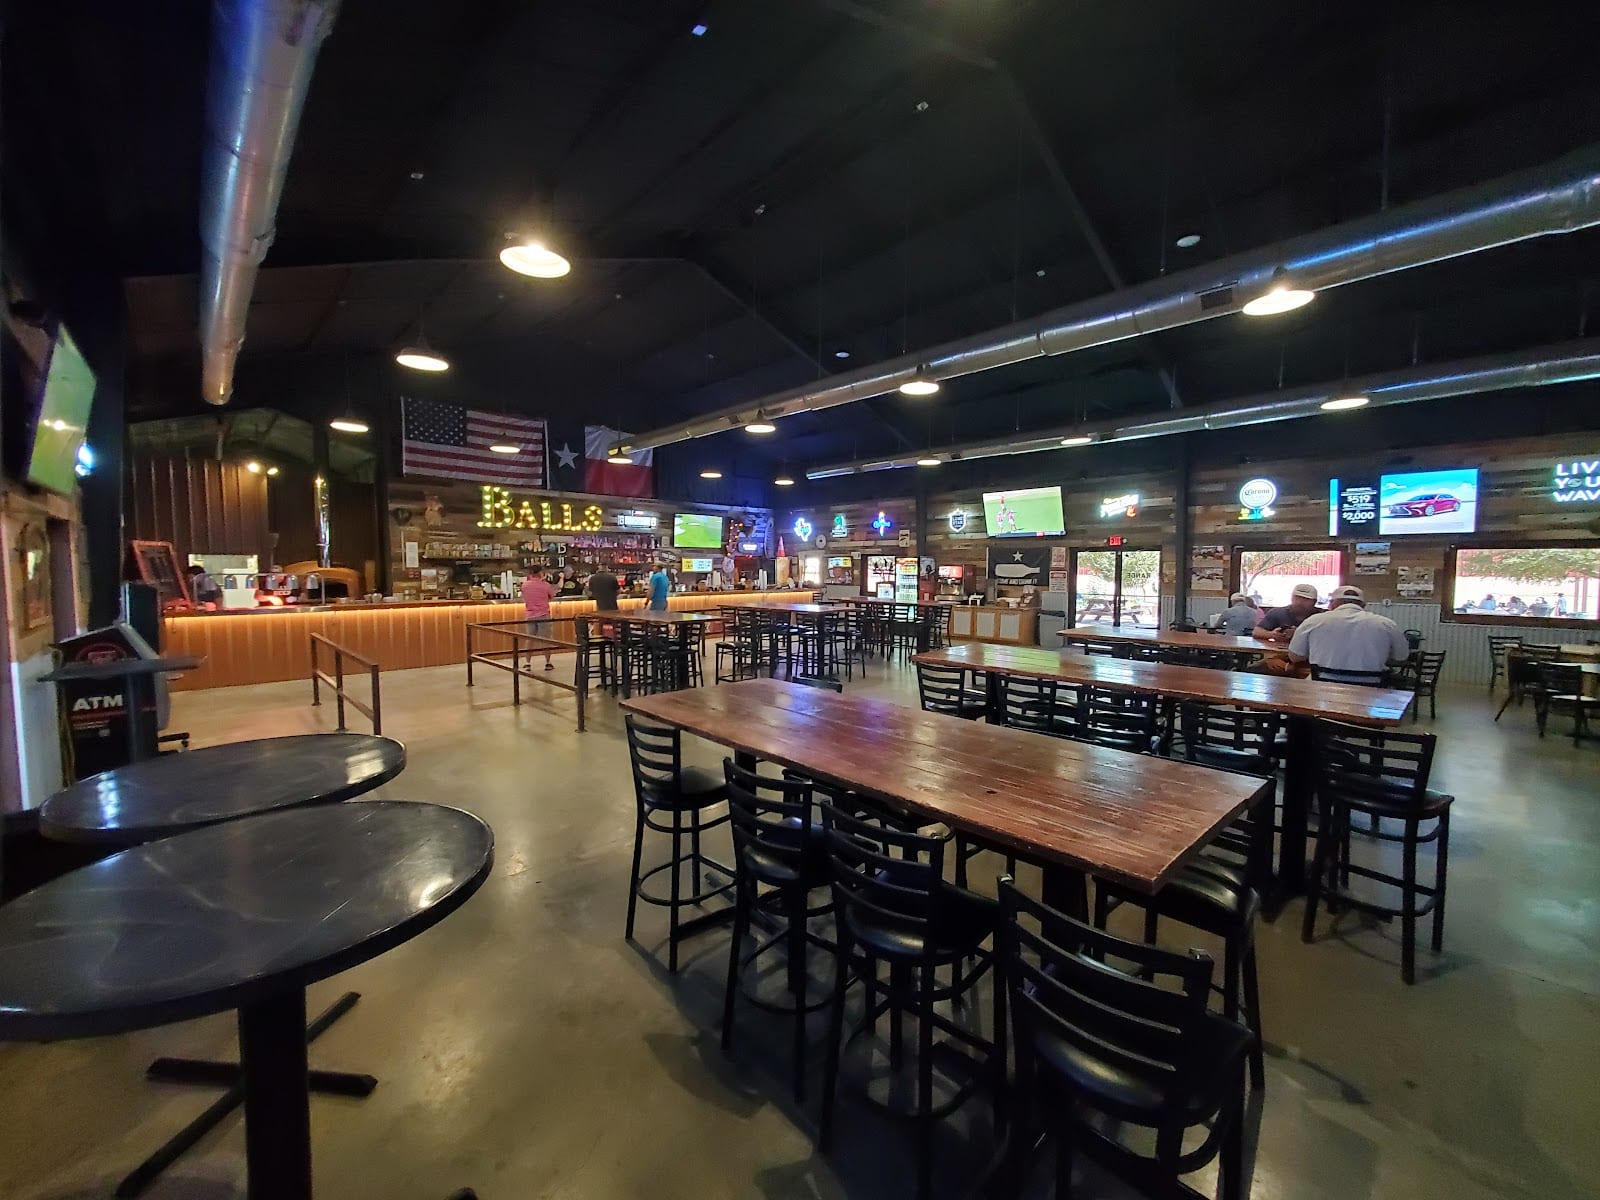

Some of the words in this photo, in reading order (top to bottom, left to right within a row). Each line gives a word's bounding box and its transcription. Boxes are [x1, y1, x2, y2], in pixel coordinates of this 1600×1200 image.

[1244, 488, 1270, 496] Corona
[1346, 494, 1371, 504] $519
[1342, 511, 1375, 520] $2,000
[72, 694, 124, 712] ATM
